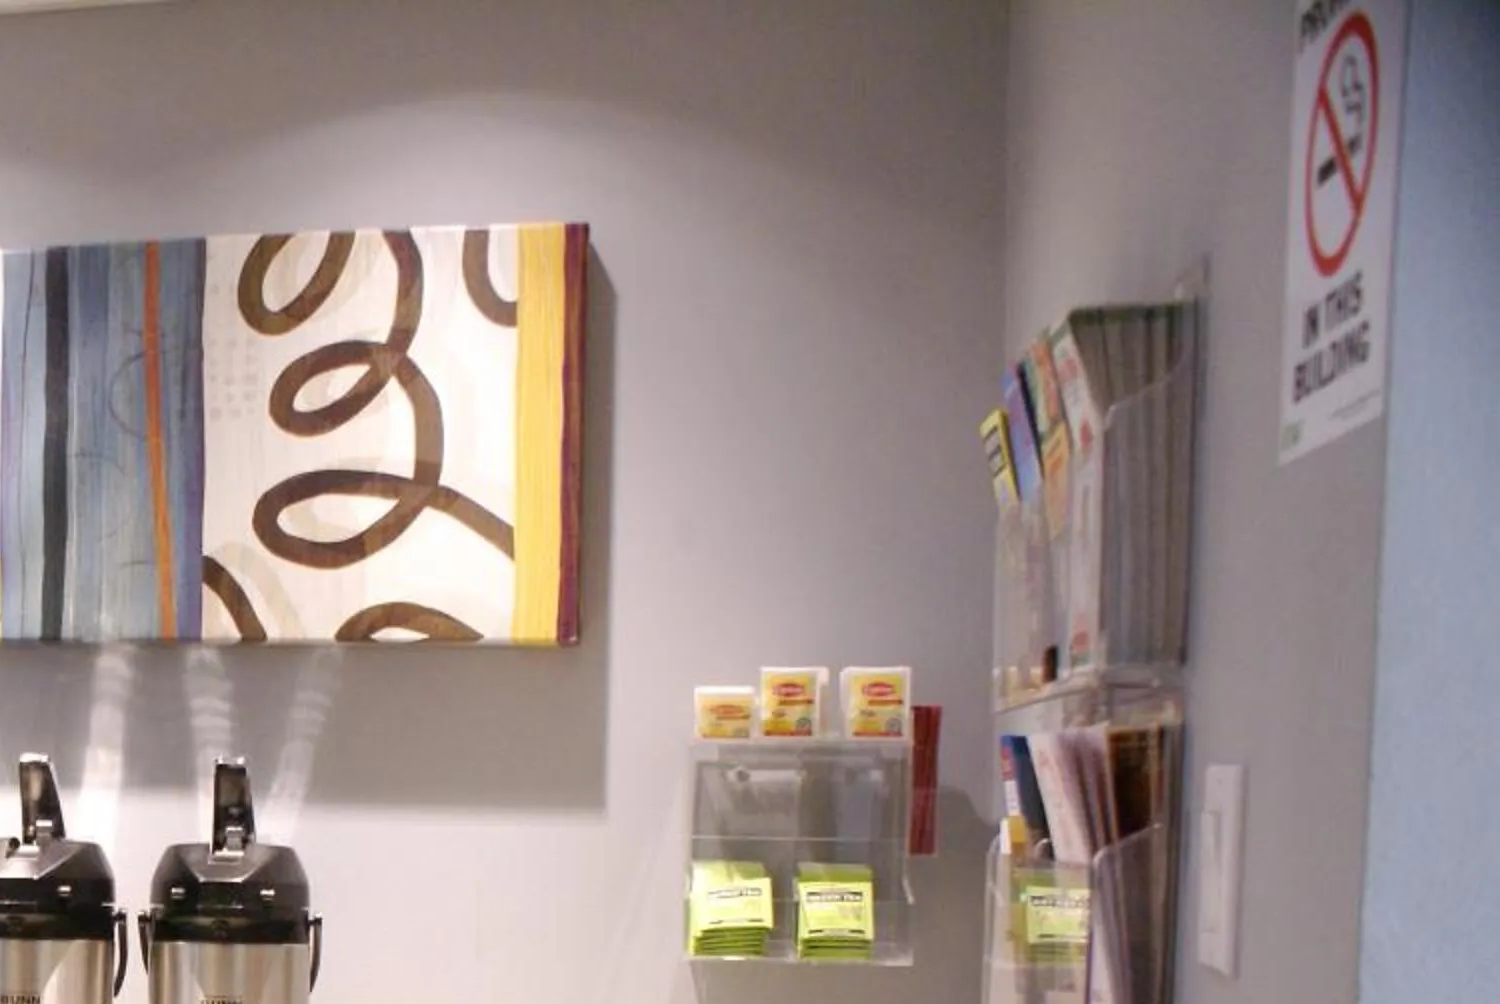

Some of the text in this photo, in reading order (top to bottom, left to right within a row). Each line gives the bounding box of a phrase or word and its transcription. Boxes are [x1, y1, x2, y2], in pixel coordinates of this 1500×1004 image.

[1301, 270, 1364, 350] IN THIS
[1292, 320, 1372, 403] BUILDING
